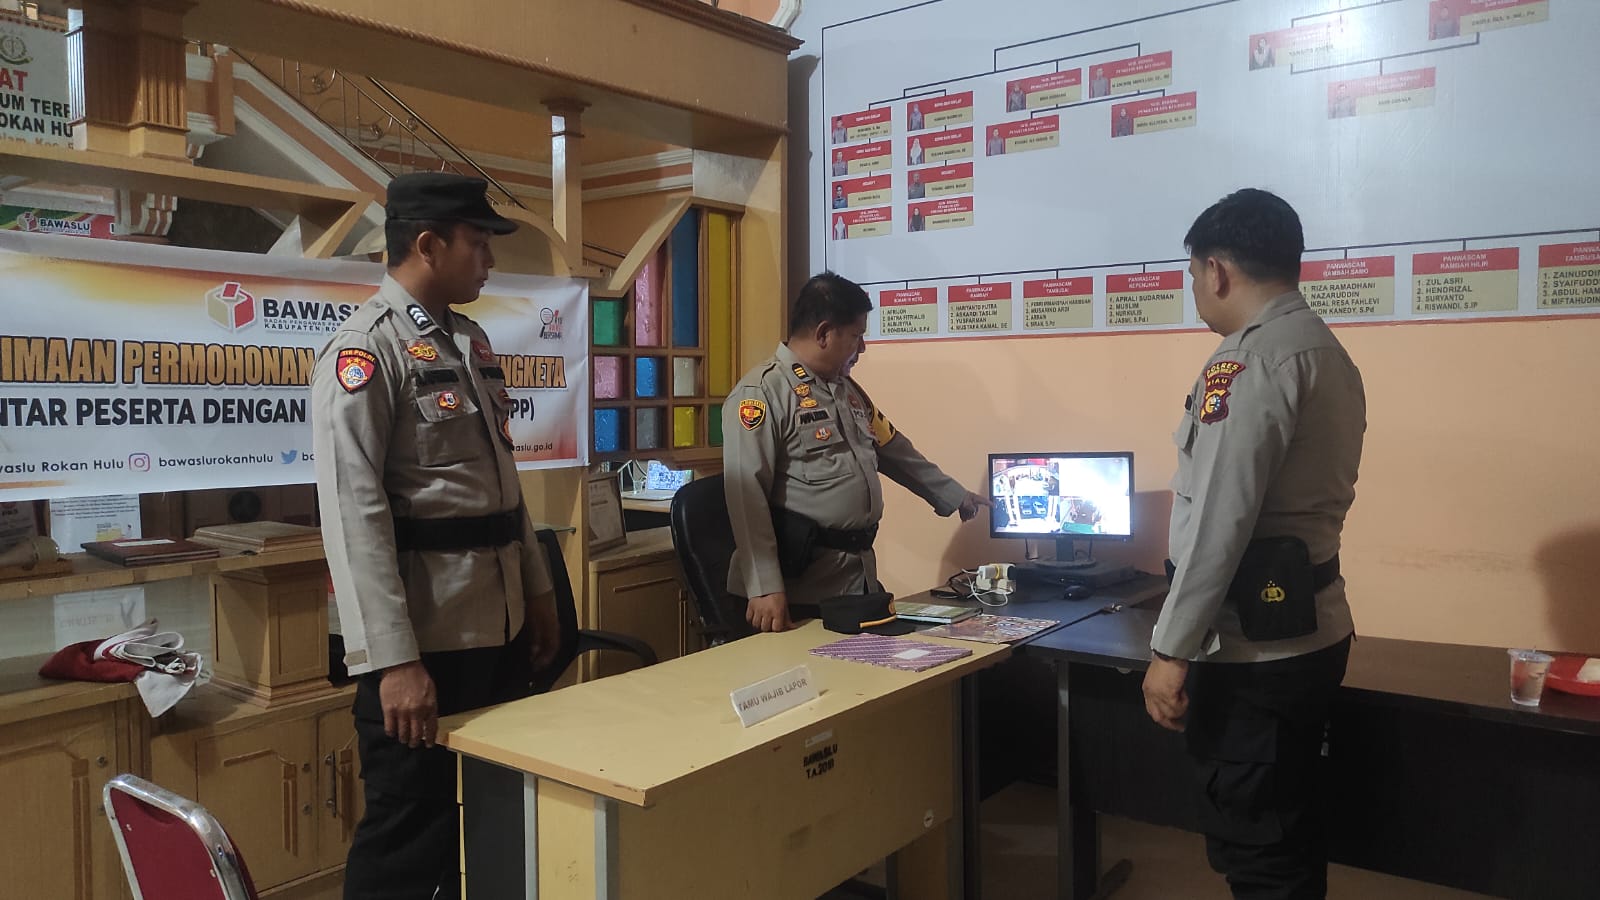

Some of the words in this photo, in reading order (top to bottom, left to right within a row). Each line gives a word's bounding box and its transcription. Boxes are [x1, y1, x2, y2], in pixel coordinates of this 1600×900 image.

[40, 219, 90, 231] BAWASLU
[1443, 253, 1487, 262] PANWASCAM
[1443, 277, 1464, 285] ASRI
[1311, 284, 1328, 292] RIZA
[1329, 282, 1376, 291] RAMADHANI
[1426, 285, 1473, 294] HENDRIZAL
[1311, 291, 1360, 300] NAZARUDDIN
[1425, 294, 1465, 303] SURYANTO
[263, 298, 360, 322] BAWAS
[1116, 302, 1140, 310] MUSLIM
[122, 340, 316, 387] PERMOHONAN
[496, 354, 567, 388] NGKETA
[76, 398, 196, 425] PESERTA
[203, 398, 306, 424] DENGAN
[509, 396, 534, 421] PP)
[41, 461, 88, 472] Rokan
[93, 459, 124, 470] Hulu
[158, 454, 274, 467] bawaslurokanhulu
[513, 443, 553, 453] aslu.go.id
[760, 687, 784, 703] WAJIB
[784, 678, 808, 694] LAPOR
